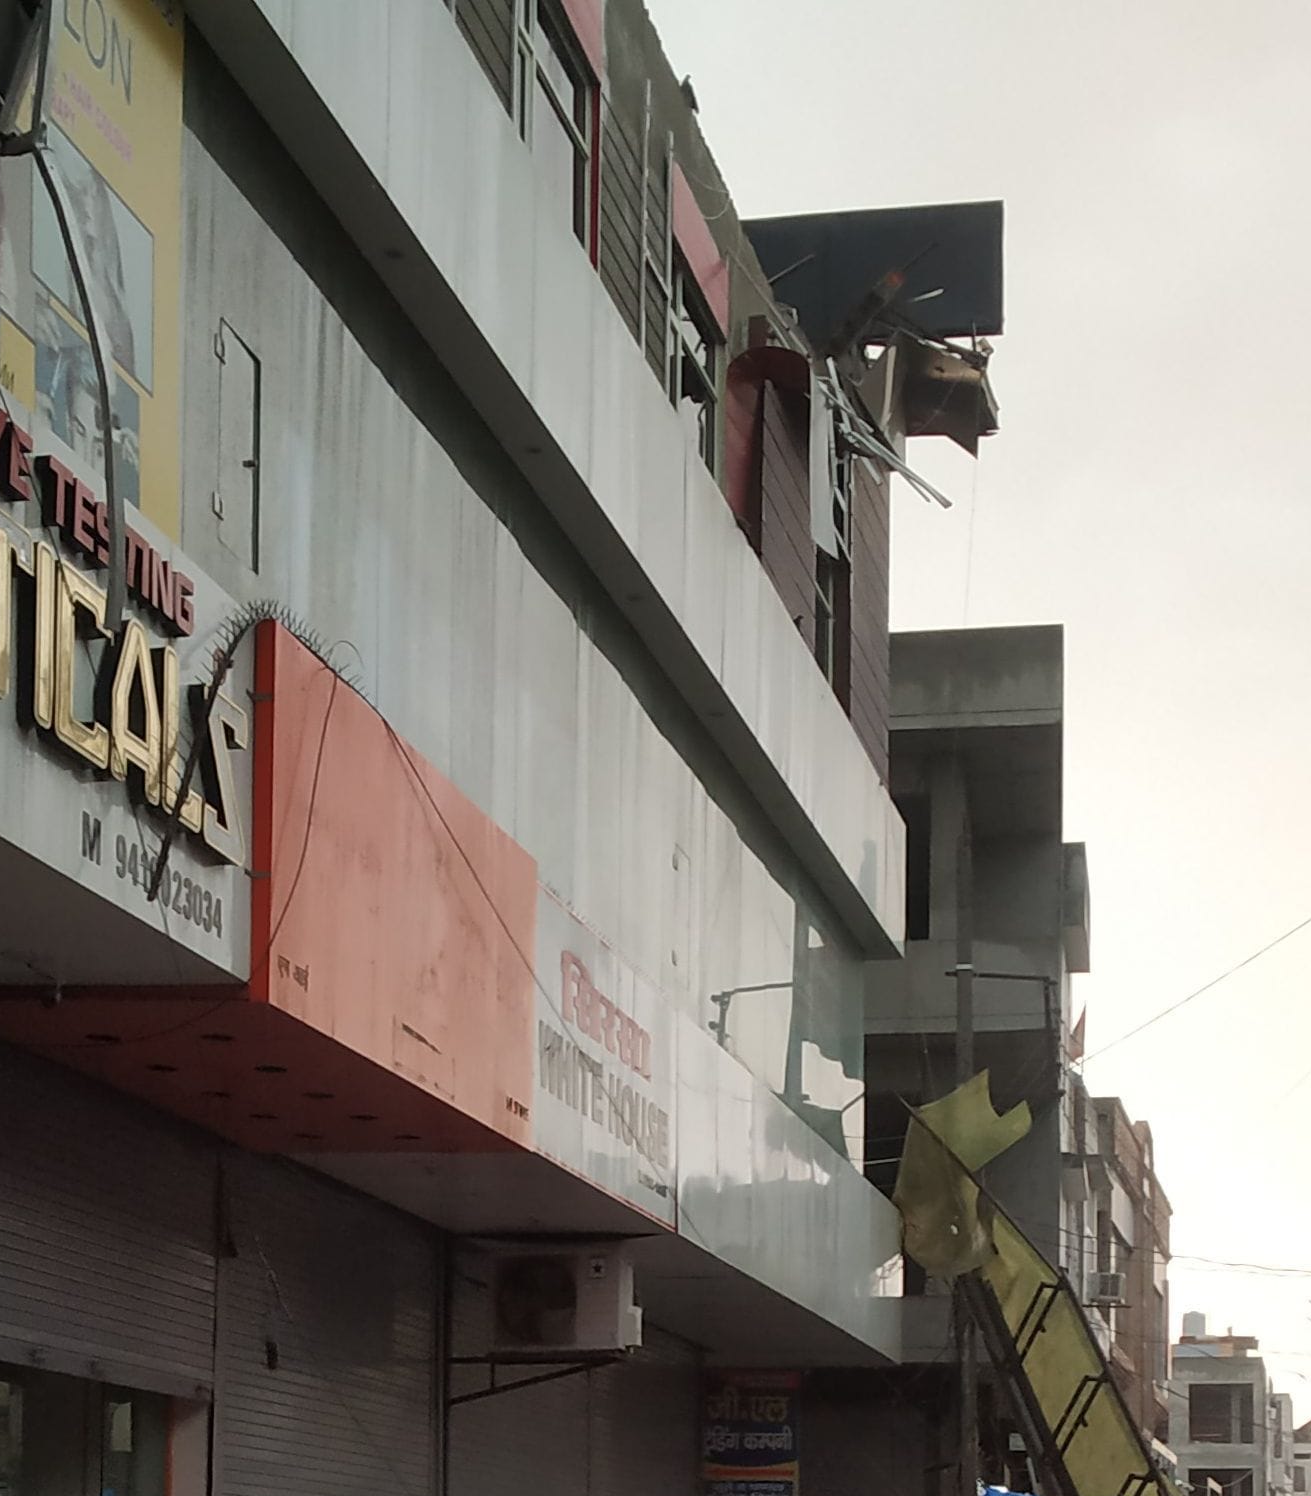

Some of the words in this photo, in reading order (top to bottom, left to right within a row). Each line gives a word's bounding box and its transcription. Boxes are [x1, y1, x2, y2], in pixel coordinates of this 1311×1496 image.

[46, 453, 196, 638] TESTING
[80, 811, 103, 866] M
[115, 834, 224, 940] 941023034
[538, 1018, 604, 1128] WHITE
[608, 1071, 669, 1171] HOUSE
